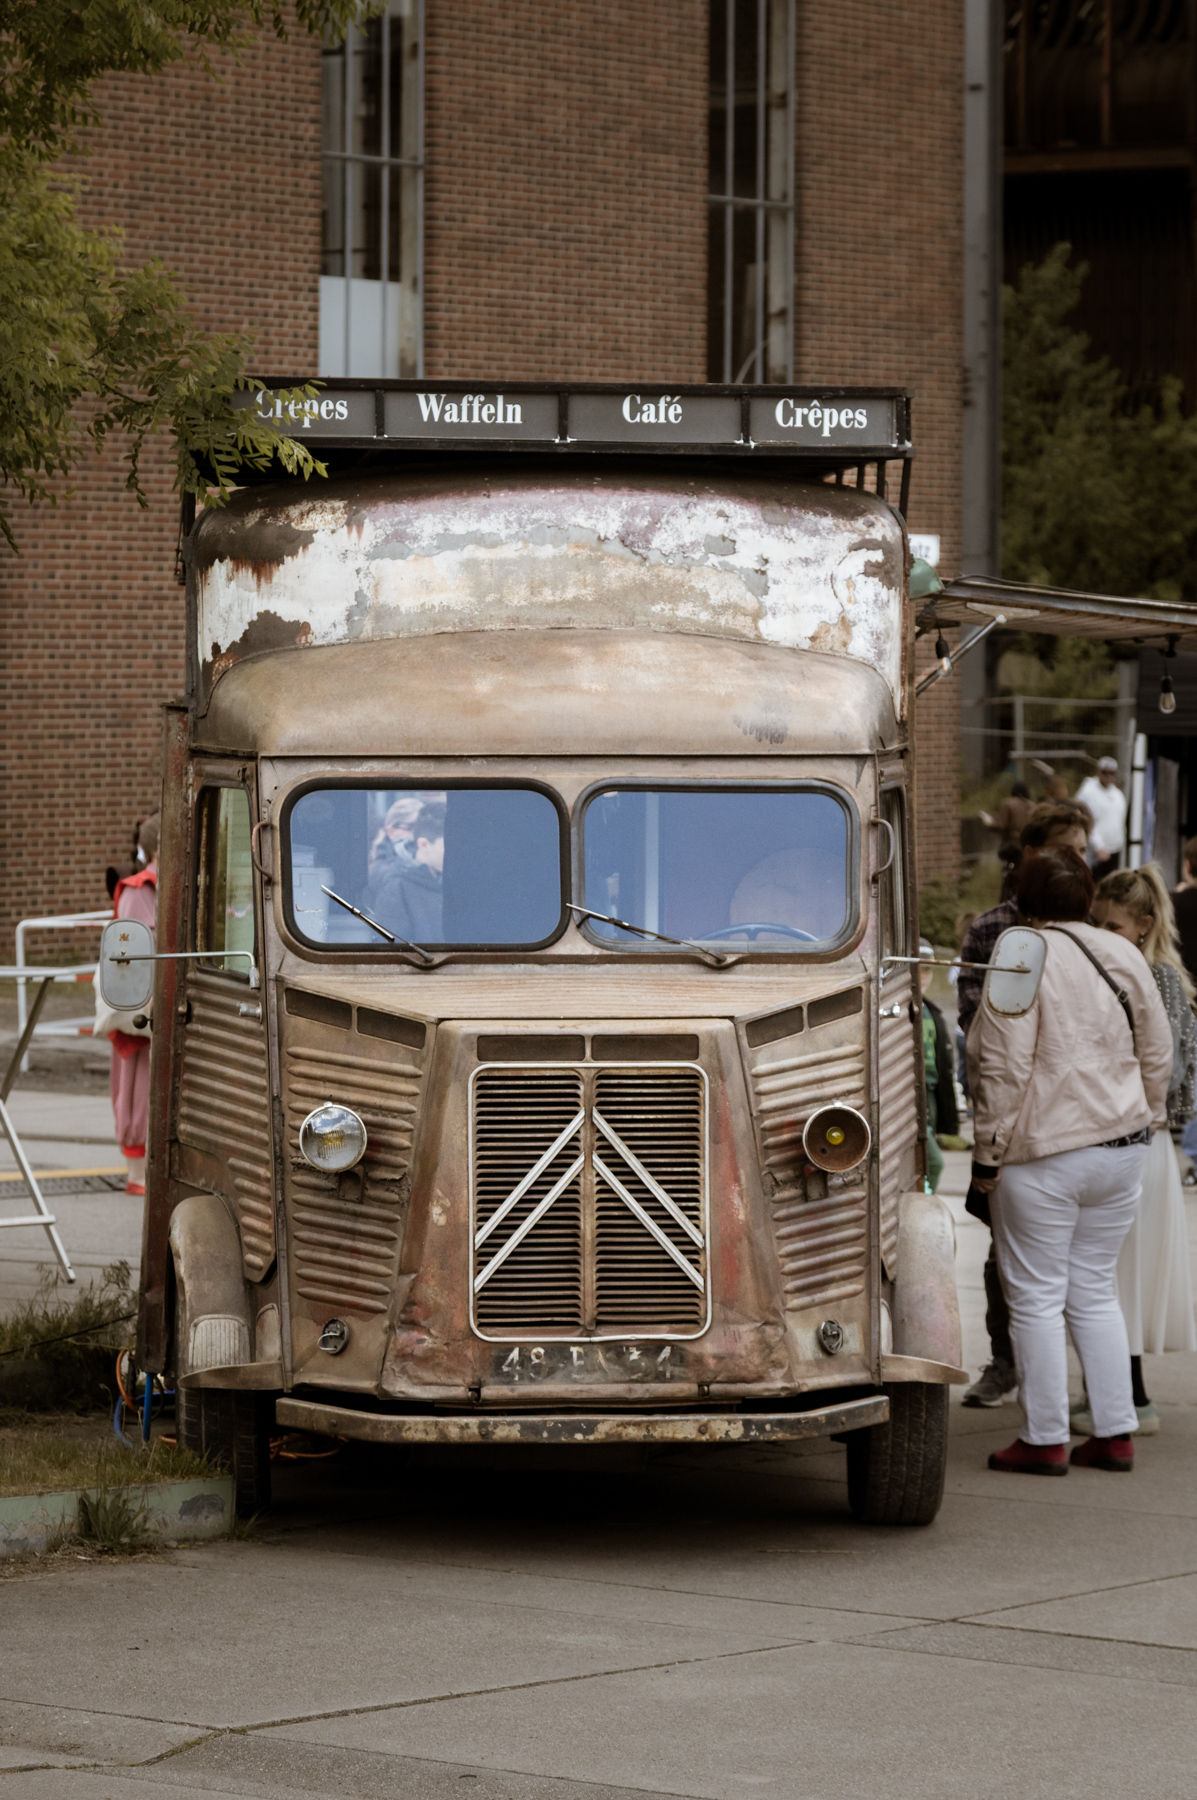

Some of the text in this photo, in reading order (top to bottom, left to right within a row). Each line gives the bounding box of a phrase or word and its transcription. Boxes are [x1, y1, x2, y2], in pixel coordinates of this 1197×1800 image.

[416, 393, 523, 425] Waffeln
[621, 393, 683, 424] Café
[774, 397, 868, 437] Crêpes
[910, 542, 931, 558] atz
